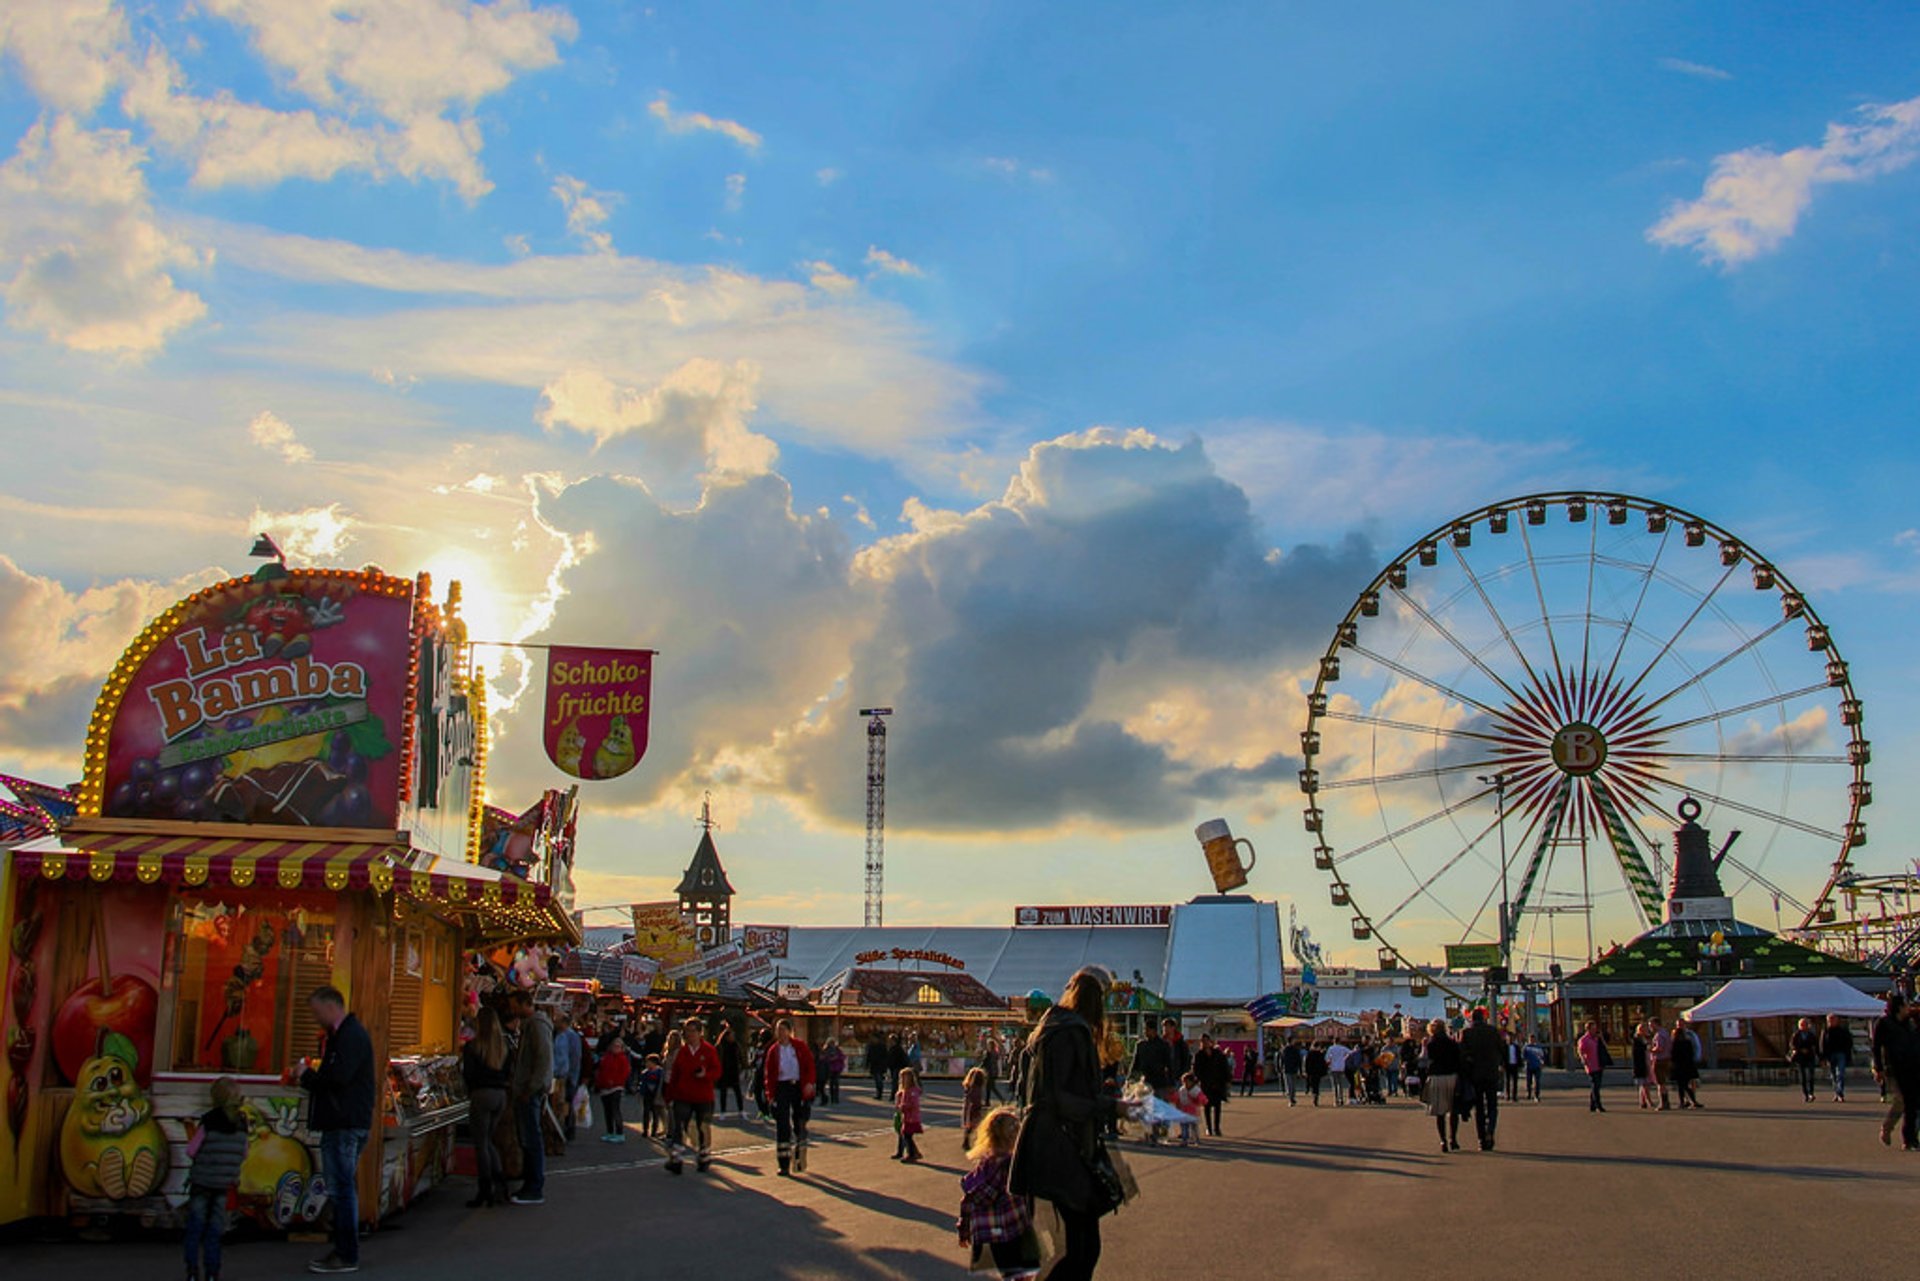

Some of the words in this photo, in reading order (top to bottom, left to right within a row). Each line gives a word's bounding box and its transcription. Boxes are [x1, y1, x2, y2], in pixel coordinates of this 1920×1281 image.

[177, 627, 262, 679] La
[552, 659, 646, 685] Schoko-
[148, 656, 365, 742] Bamba
[552, 690, 645, 726] früchte
[1042, 911, 1065, 925] ZUM
[1068, 906, 1164, 925] WASENWIRT
